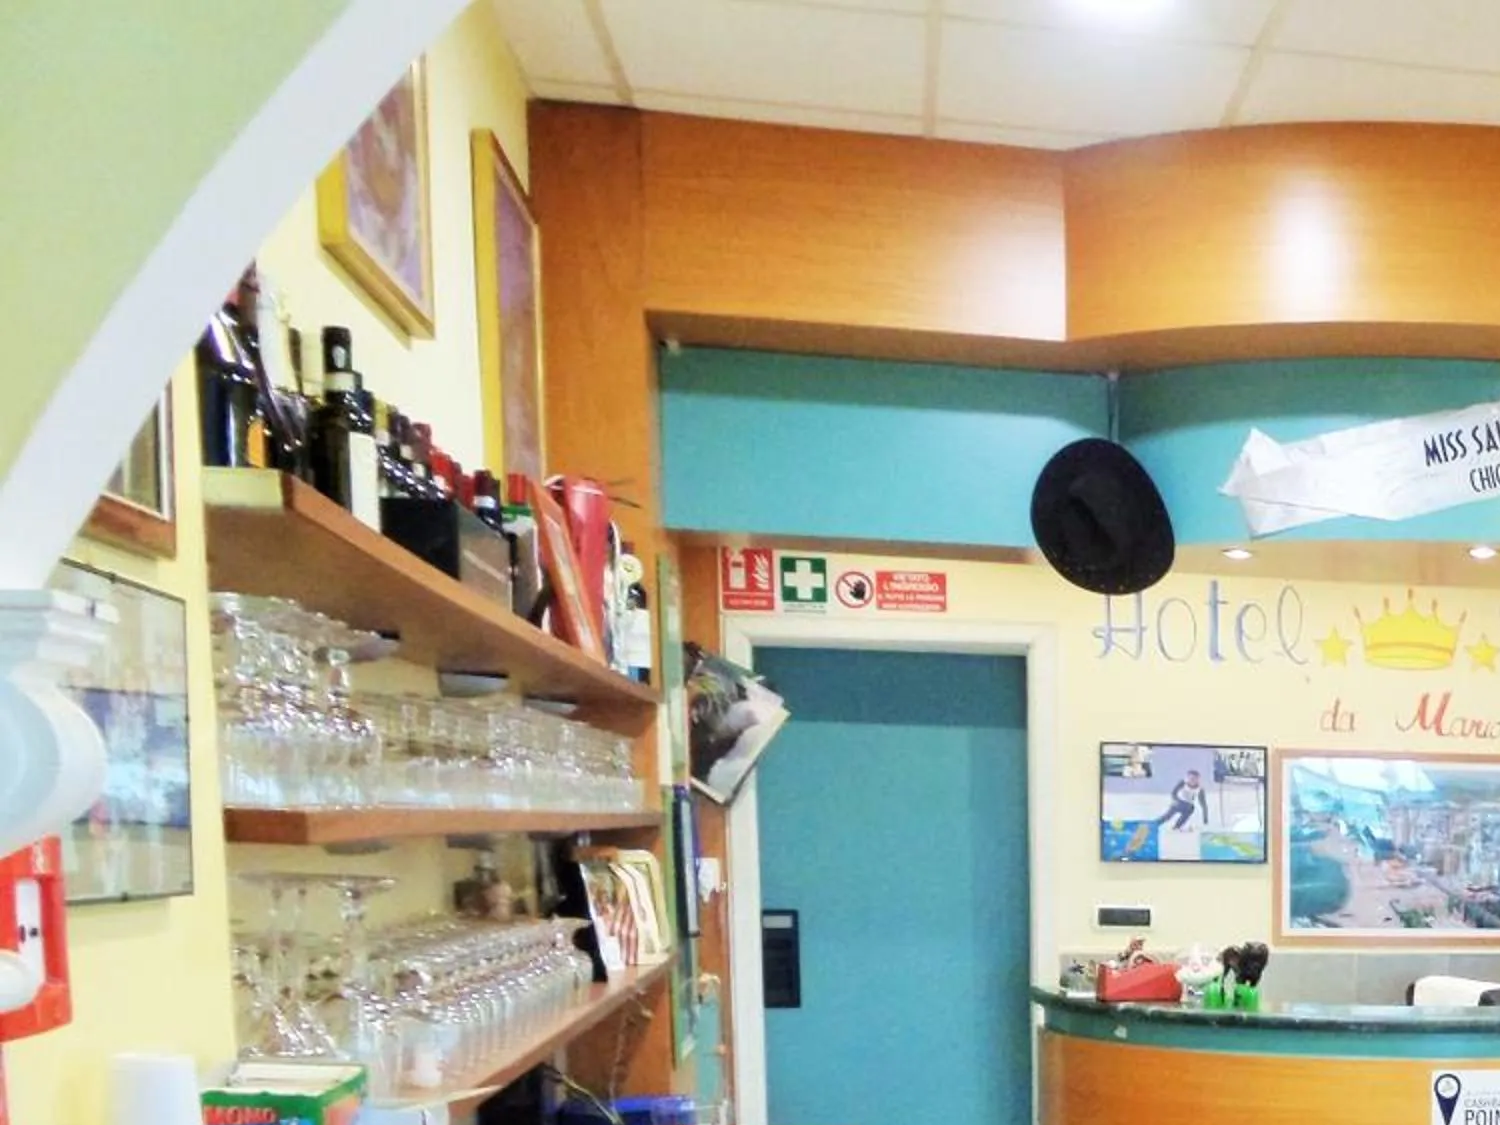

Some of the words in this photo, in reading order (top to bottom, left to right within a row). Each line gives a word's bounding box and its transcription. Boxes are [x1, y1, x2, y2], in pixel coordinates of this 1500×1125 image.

[1423, 428, 1468, 467] MISS
[1091, 579, 1310, 666] Hotel
[1319, 697, 1356, 733] da
